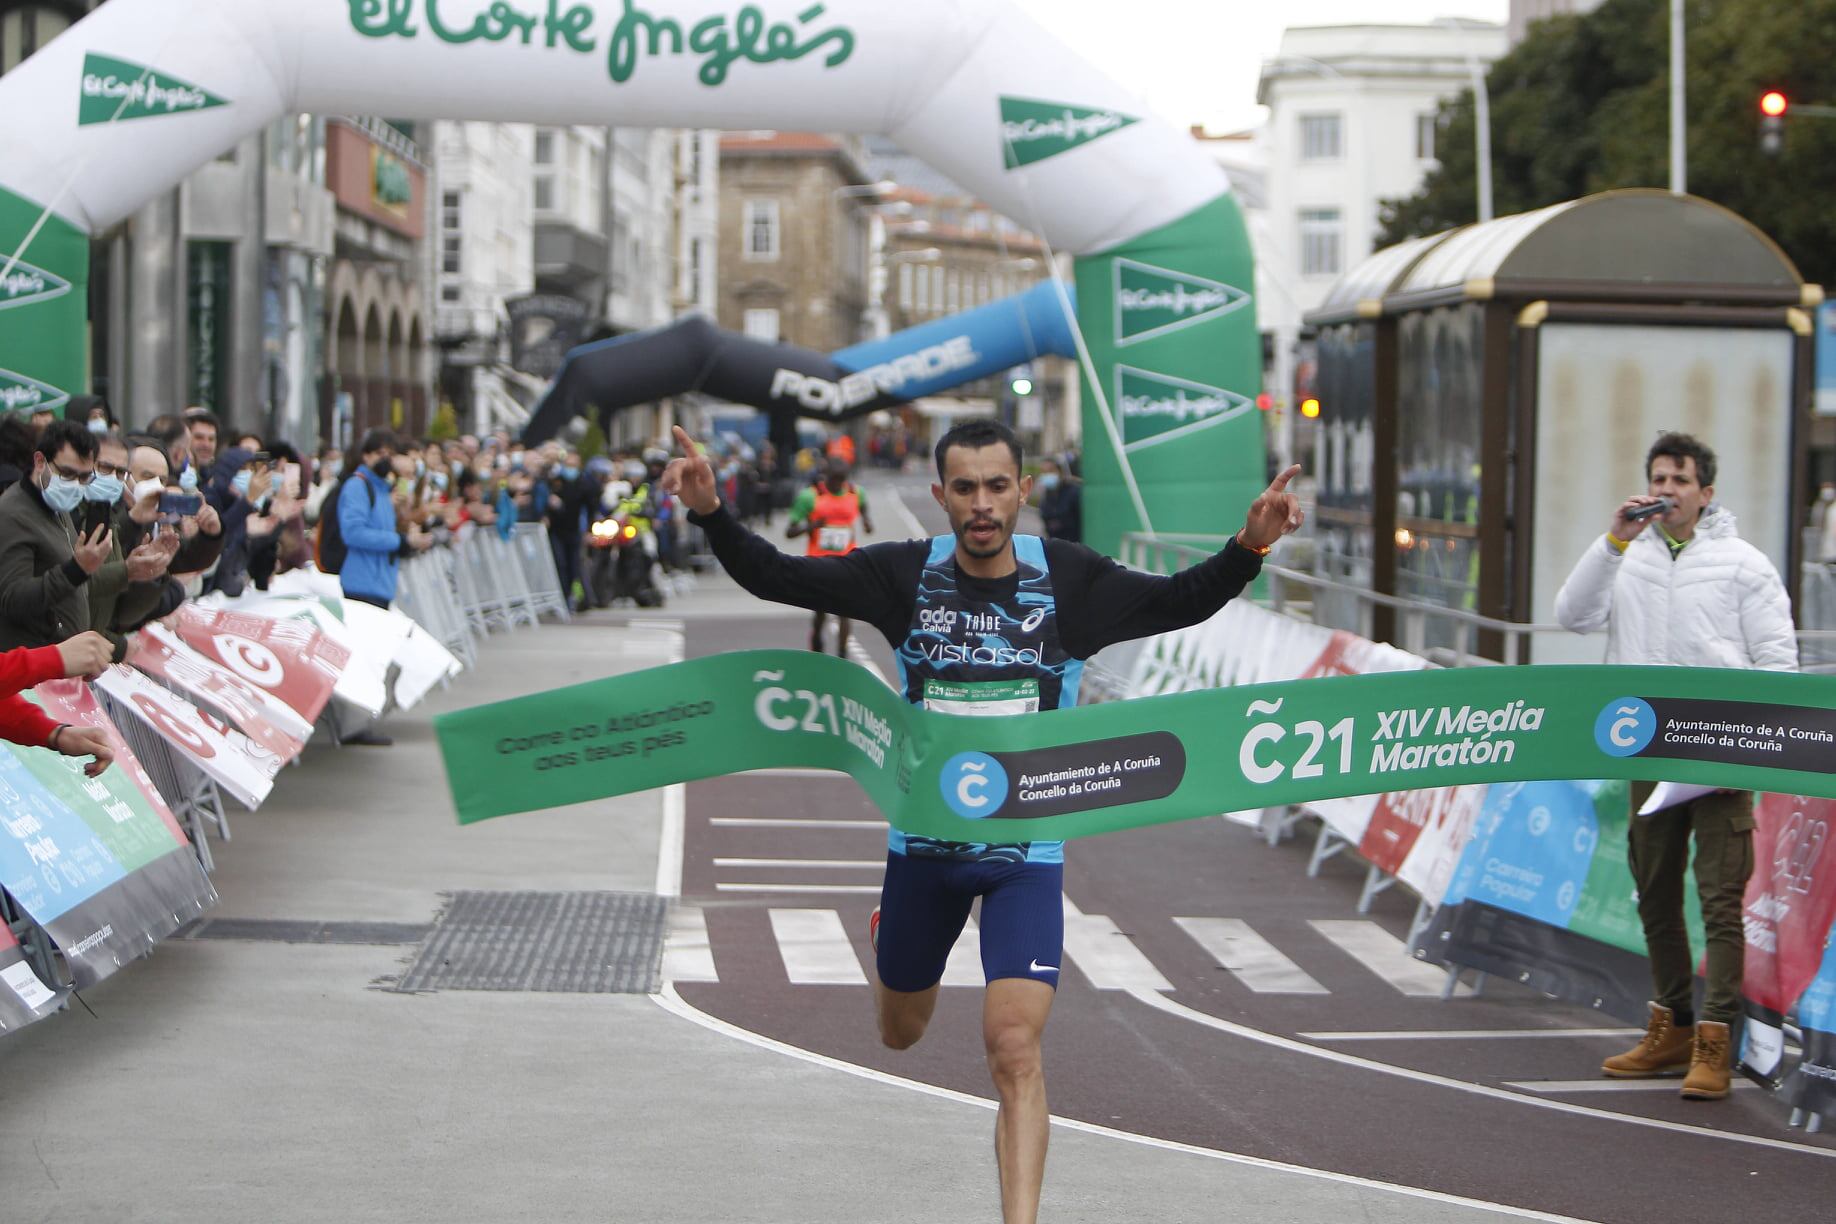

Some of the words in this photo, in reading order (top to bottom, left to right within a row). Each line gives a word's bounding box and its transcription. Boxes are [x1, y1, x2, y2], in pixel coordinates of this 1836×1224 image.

[425, 0, 596, 52] Corte
[919, 606, 957, 624] ada
[965, 611, 1001, 631] TRIBE
[919, 640, 1044, 665] vistasol
[496, 731, 564, 754] Corre
[570, 724, 599, 742] co
[607, 700, 715, 733] Atlántico
[864, 707, 892, 748] Media
[1371, 708, 1434, 741] XIV
[1434, 700, 1545, 736] Media
[1665, 718, 1753, 735] Ayuntamiento
[1756, 724, 1772, 736] de
[1775, 726, 1785, 738] A
[1788, 727, 1834, 742] Coruña
[534, 752, 578, 771] aos
[584, 741, 638, 761] teus
[642, 728, 687, 757] pés
[845, 721, 885, 769] Maratón
[1369, 731, 1515, 774] Maratón
[1664, 732, 1716, 745] Concello
[1718, 735, 1734, 747] da
[1737, 736, 1783, 752] Coruña
[1018, 766, 1095, 788] Ayuntamiento
[1097, 759, 1112, 775] de
[1113, 761, 1122, 772] A
[1123, 755, 1161, 770] Coruña
[1018, 785, 1067, 802] Concello
[1068, 782, 1082, 795] da
[1084, 777, 1121, 792] Coruña
